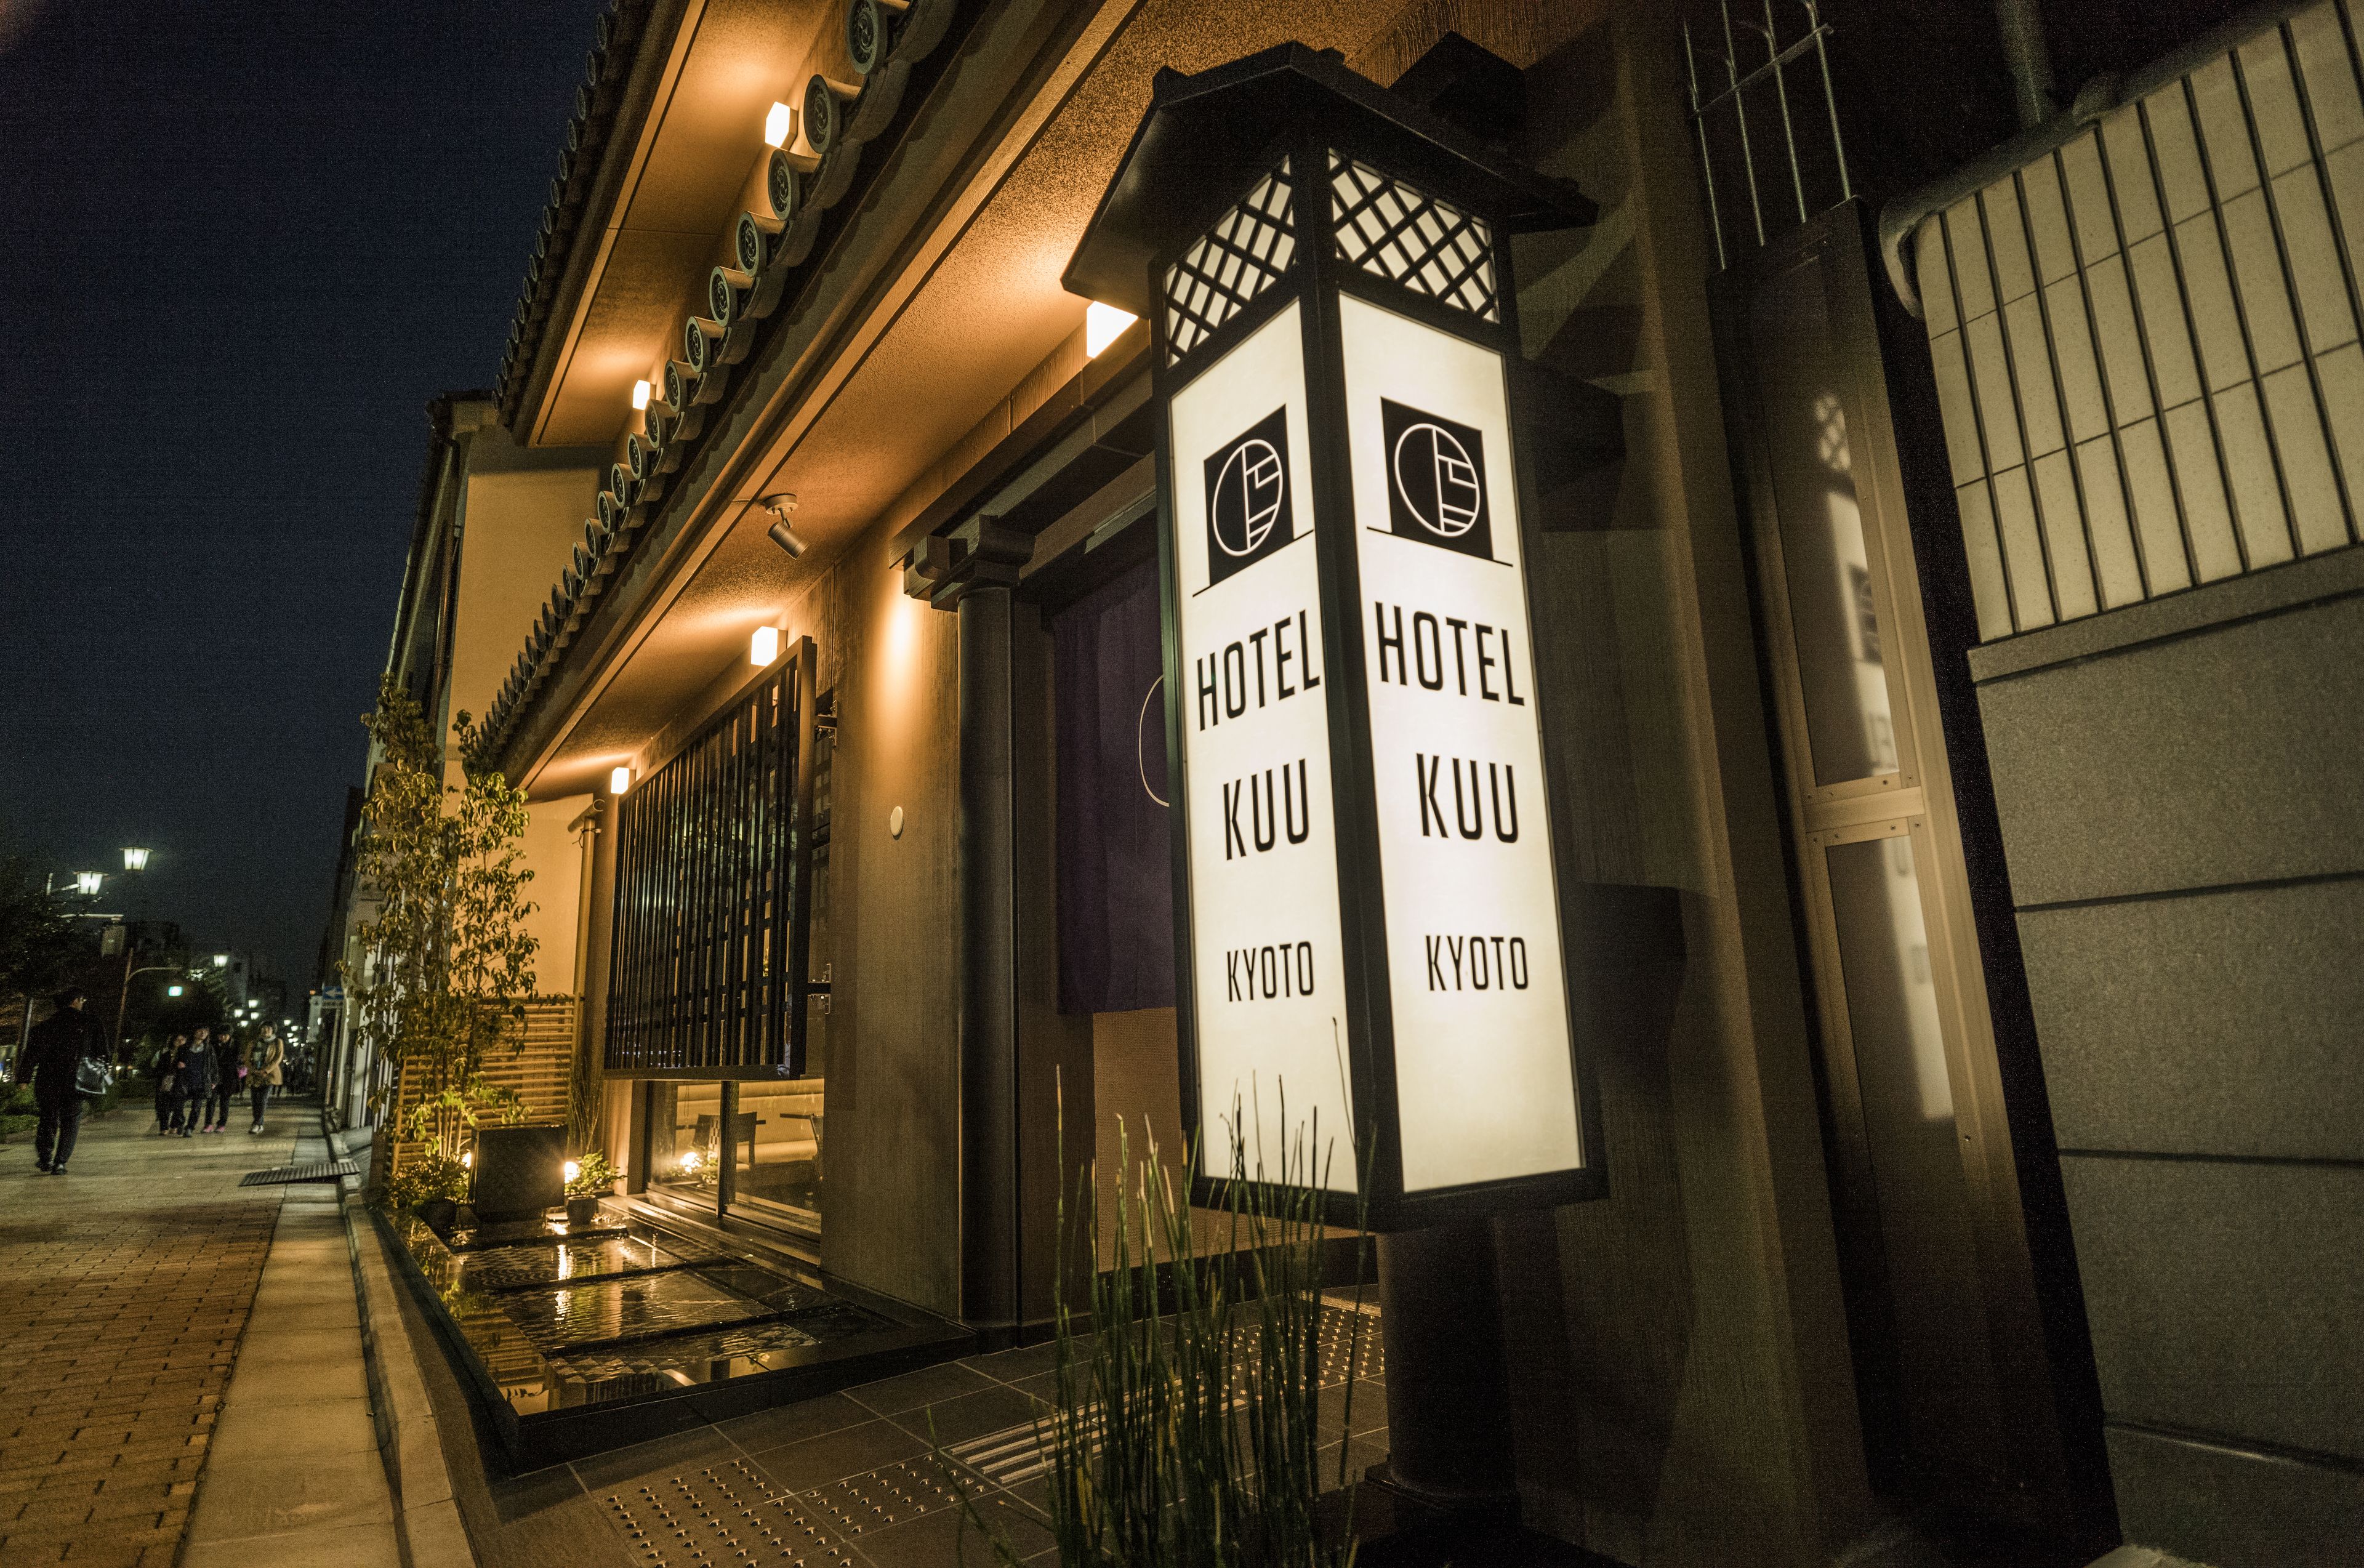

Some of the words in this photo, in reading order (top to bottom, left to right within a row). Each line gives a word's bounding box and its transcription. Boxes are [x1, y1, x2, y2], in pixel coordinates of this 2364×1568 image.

[1196, 609, 1321, 731] HOTEL
[1375, 601, 1525, 707] HOTEL
[1223, 758, 1309, 861] KUU
[1416, 752, 1519, 843] KUU
[1226, 941, 1314, 1002] KYOTO
[1426, 935, 1529, 991] KYOTO
